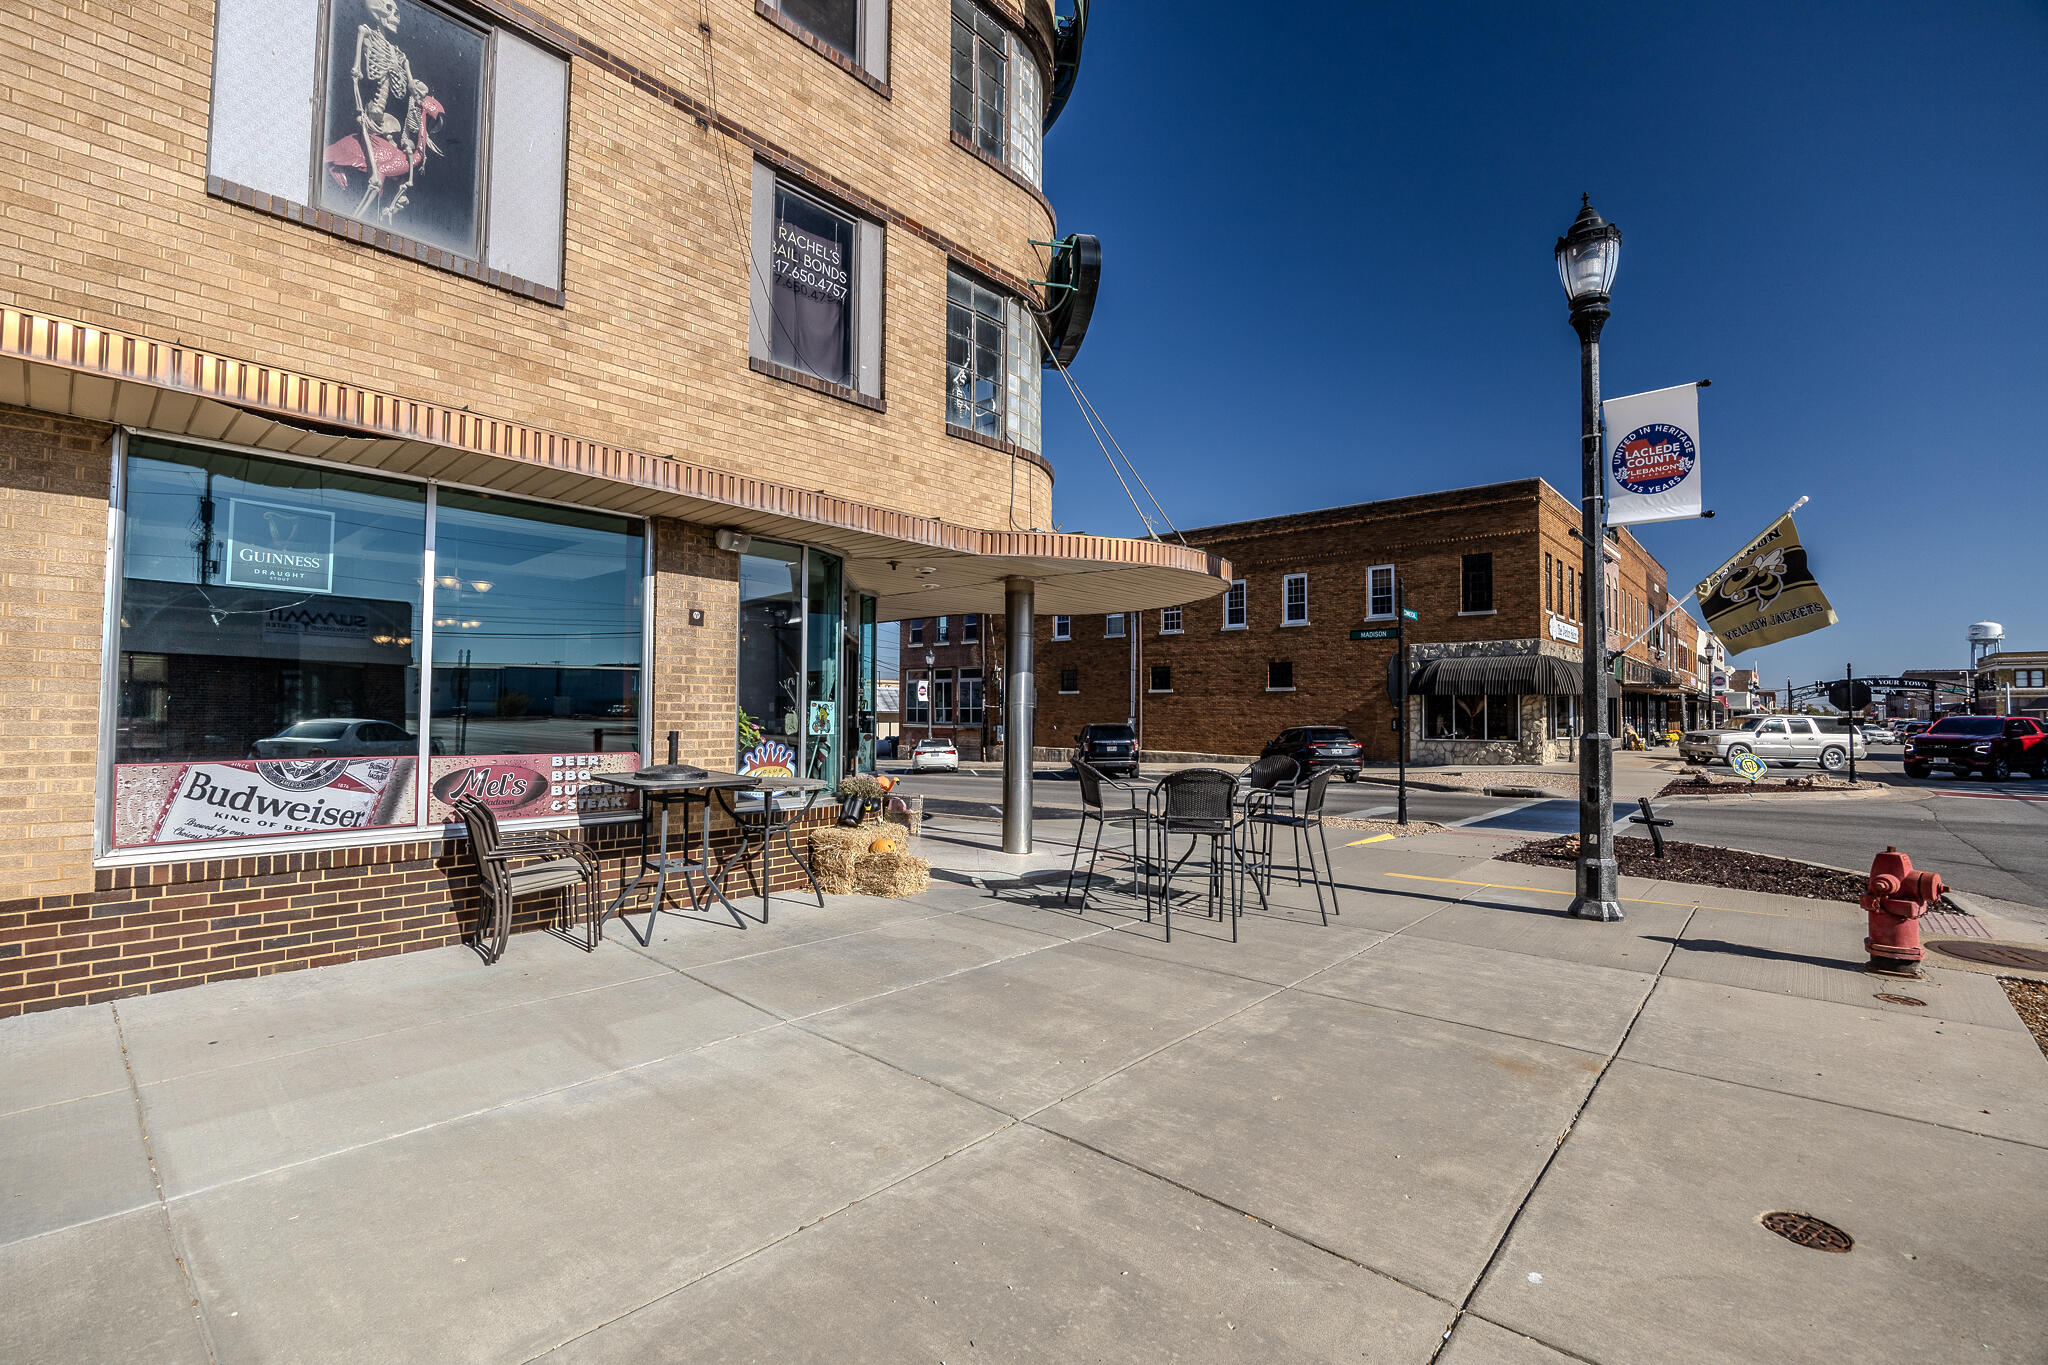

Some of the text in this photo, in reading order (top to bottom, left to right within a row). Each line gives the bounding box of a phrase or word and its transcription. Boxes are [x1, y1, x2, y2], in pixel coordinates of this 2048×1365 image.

[779, 226, 840, 265] RACHEL'S
[803, 254, 847, 284] BONDS
[1613, 425, 1694, 465] UNITED IN HERITAGE
[1625, 442, 1680, 459] LACLEDE
[1627, 451, 1680, 468] COUNTY
[1630, 464, 1677, 476] LEBANON
[1626, 476, 1681, 493] 175 YEARS
[239, 548, 320, 569] GUINNESS
[254, 568, 305, 579] DRAUGHT
[1723, 602, 1824, 641] YELLOW JACKETS
[1360, 630, 1387, 638] MADISON
[551, 755, 601, 767] BEER
[449, 768, 528, 799] Mel's
[551, 770, 592, 782] BBQ
[183, 770, 366, 828] Budweiser
[551, 801, 563, 811] &
[184, 818, 217, 832] Brewed
[217, 824, 229, 835] by
[214, 811, 251, 824] KING
[257, 819, 278, 828] OF
